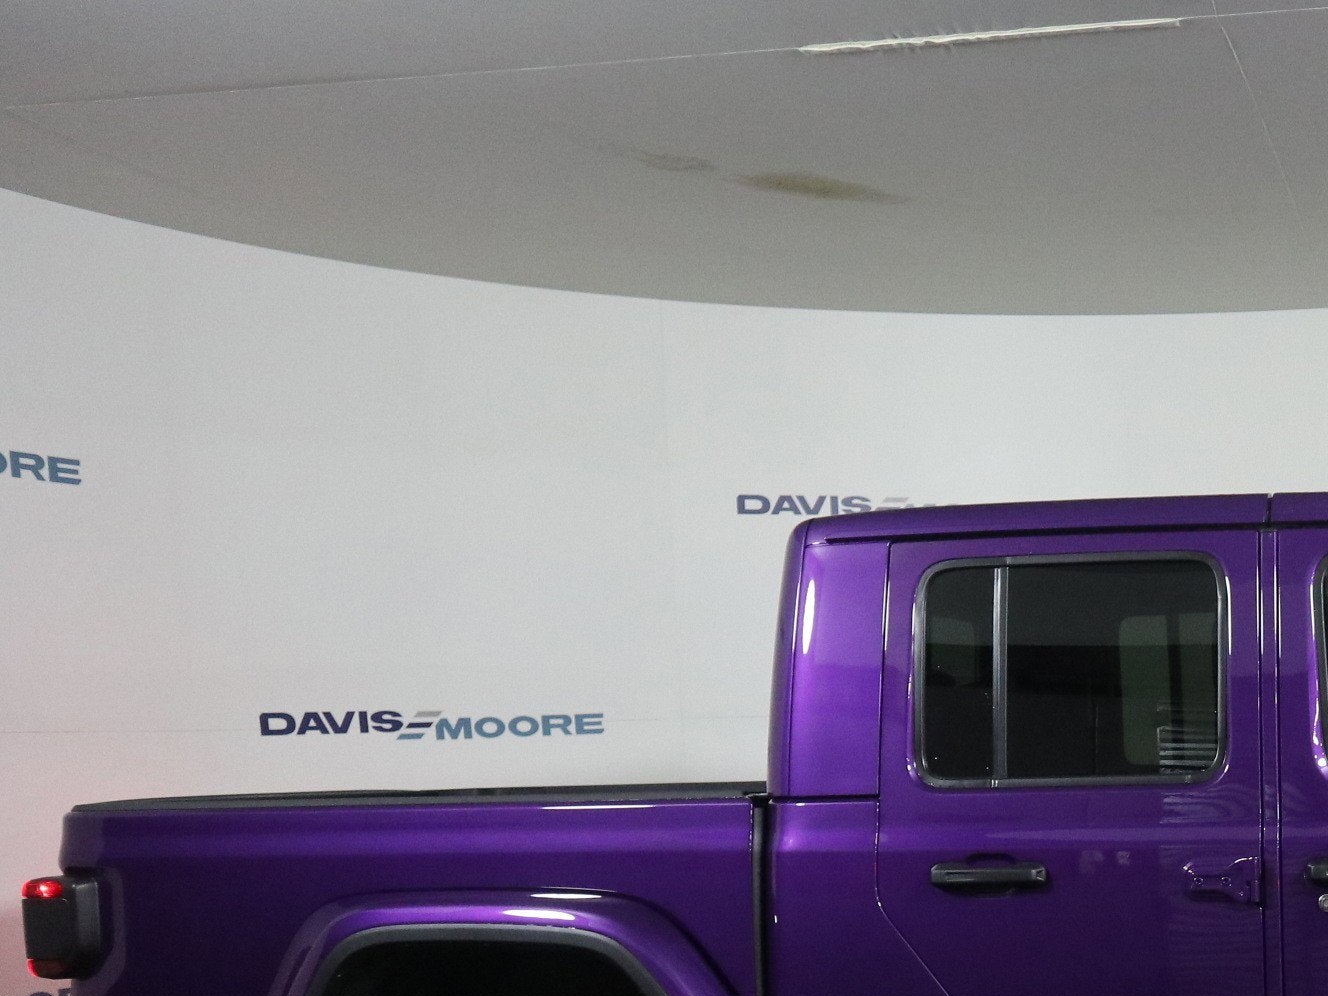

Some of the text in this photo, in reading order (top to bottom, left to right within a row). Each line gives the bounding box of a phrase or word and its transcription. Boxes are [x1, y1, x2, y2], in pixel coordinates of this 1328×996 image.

[0, 450, 82, 485] RE
[737, 494, 872, 515] DAVIS
[259, 710, 604, 740] DAVIS MOORE
